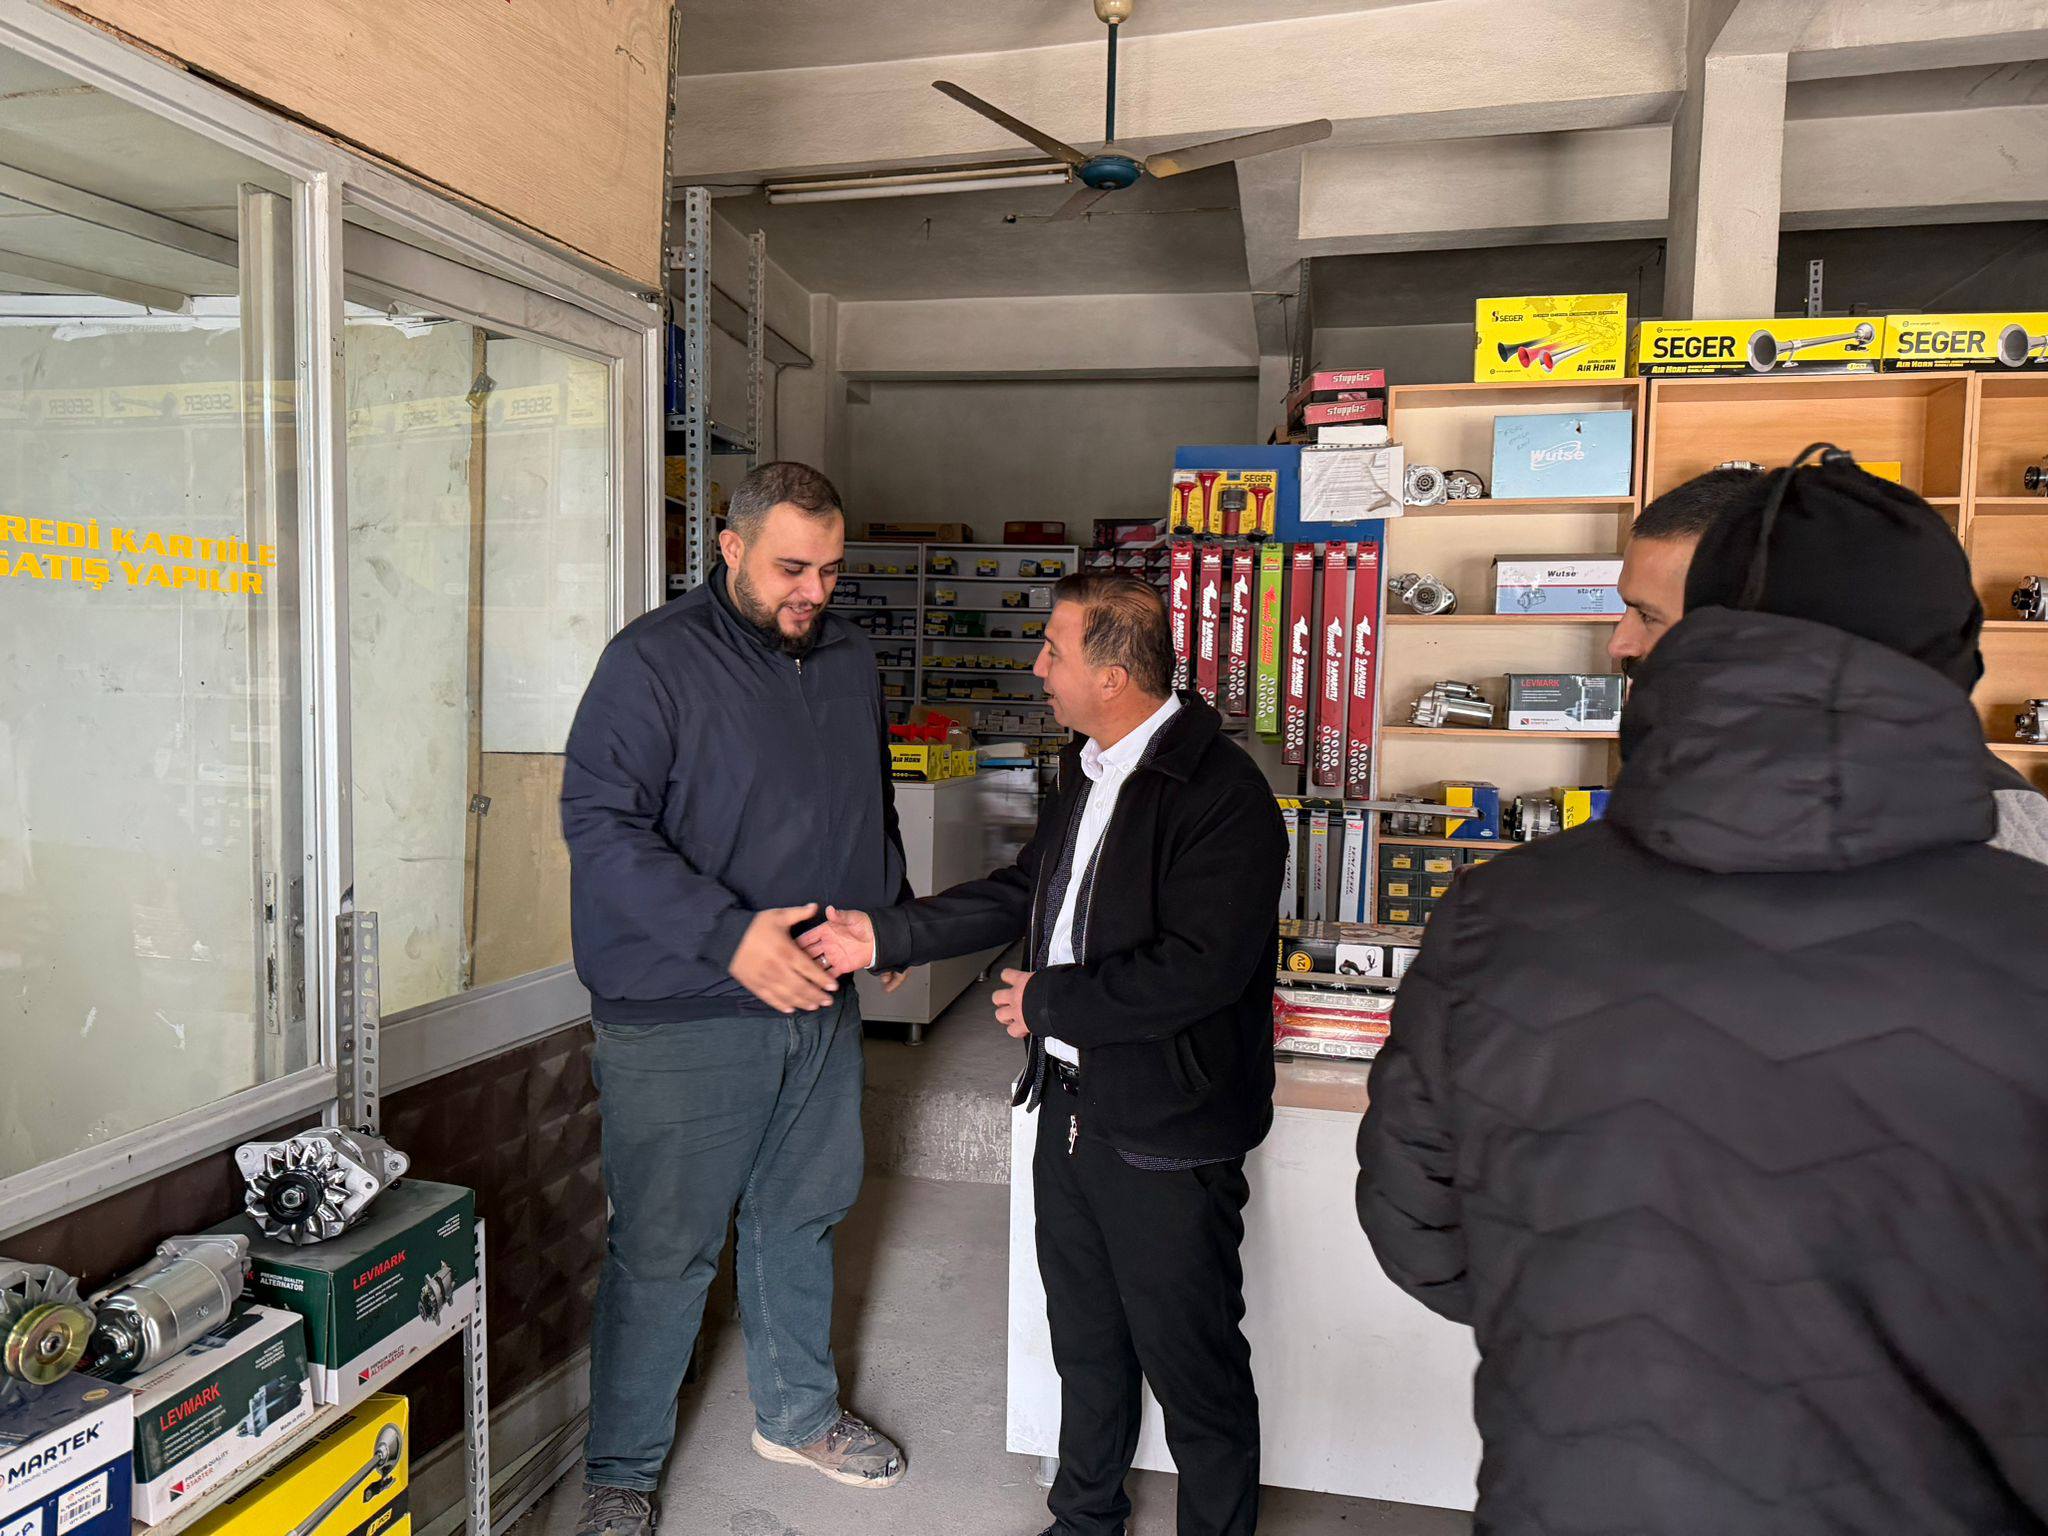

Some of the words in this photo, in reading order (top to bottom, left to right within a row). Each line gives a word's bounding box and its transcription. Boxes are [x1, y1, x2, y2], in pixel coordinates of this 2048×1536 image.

[1500, 315, 1524, 323] SEGER
[1653, 336, 1736, 358] SEGER
[1897, 331, 1986, 354] SEGER
[1577, 364, 1592, 372] AIR
[1593, 363, 1617, 372] HORN
[1244, 474, 1272, 483] SEGER
[119, 560, 263, 595] YAPILIR
[1547, 570, 1577, 578] Wutse
[1521, 679, 1560, 687] LEVMARK
[353, 1251, 407, 1291] LEVMARK
[260, 1278, 304, 1292] ALTERNATOR
[371, 1350, 405, 1377] ALTERNATOR
[159, 1382, 222, 1432] LEVMARK
[8, 1423, 100, 1484] MARTEK
[186, 1467, 214, 1490] STARTER
